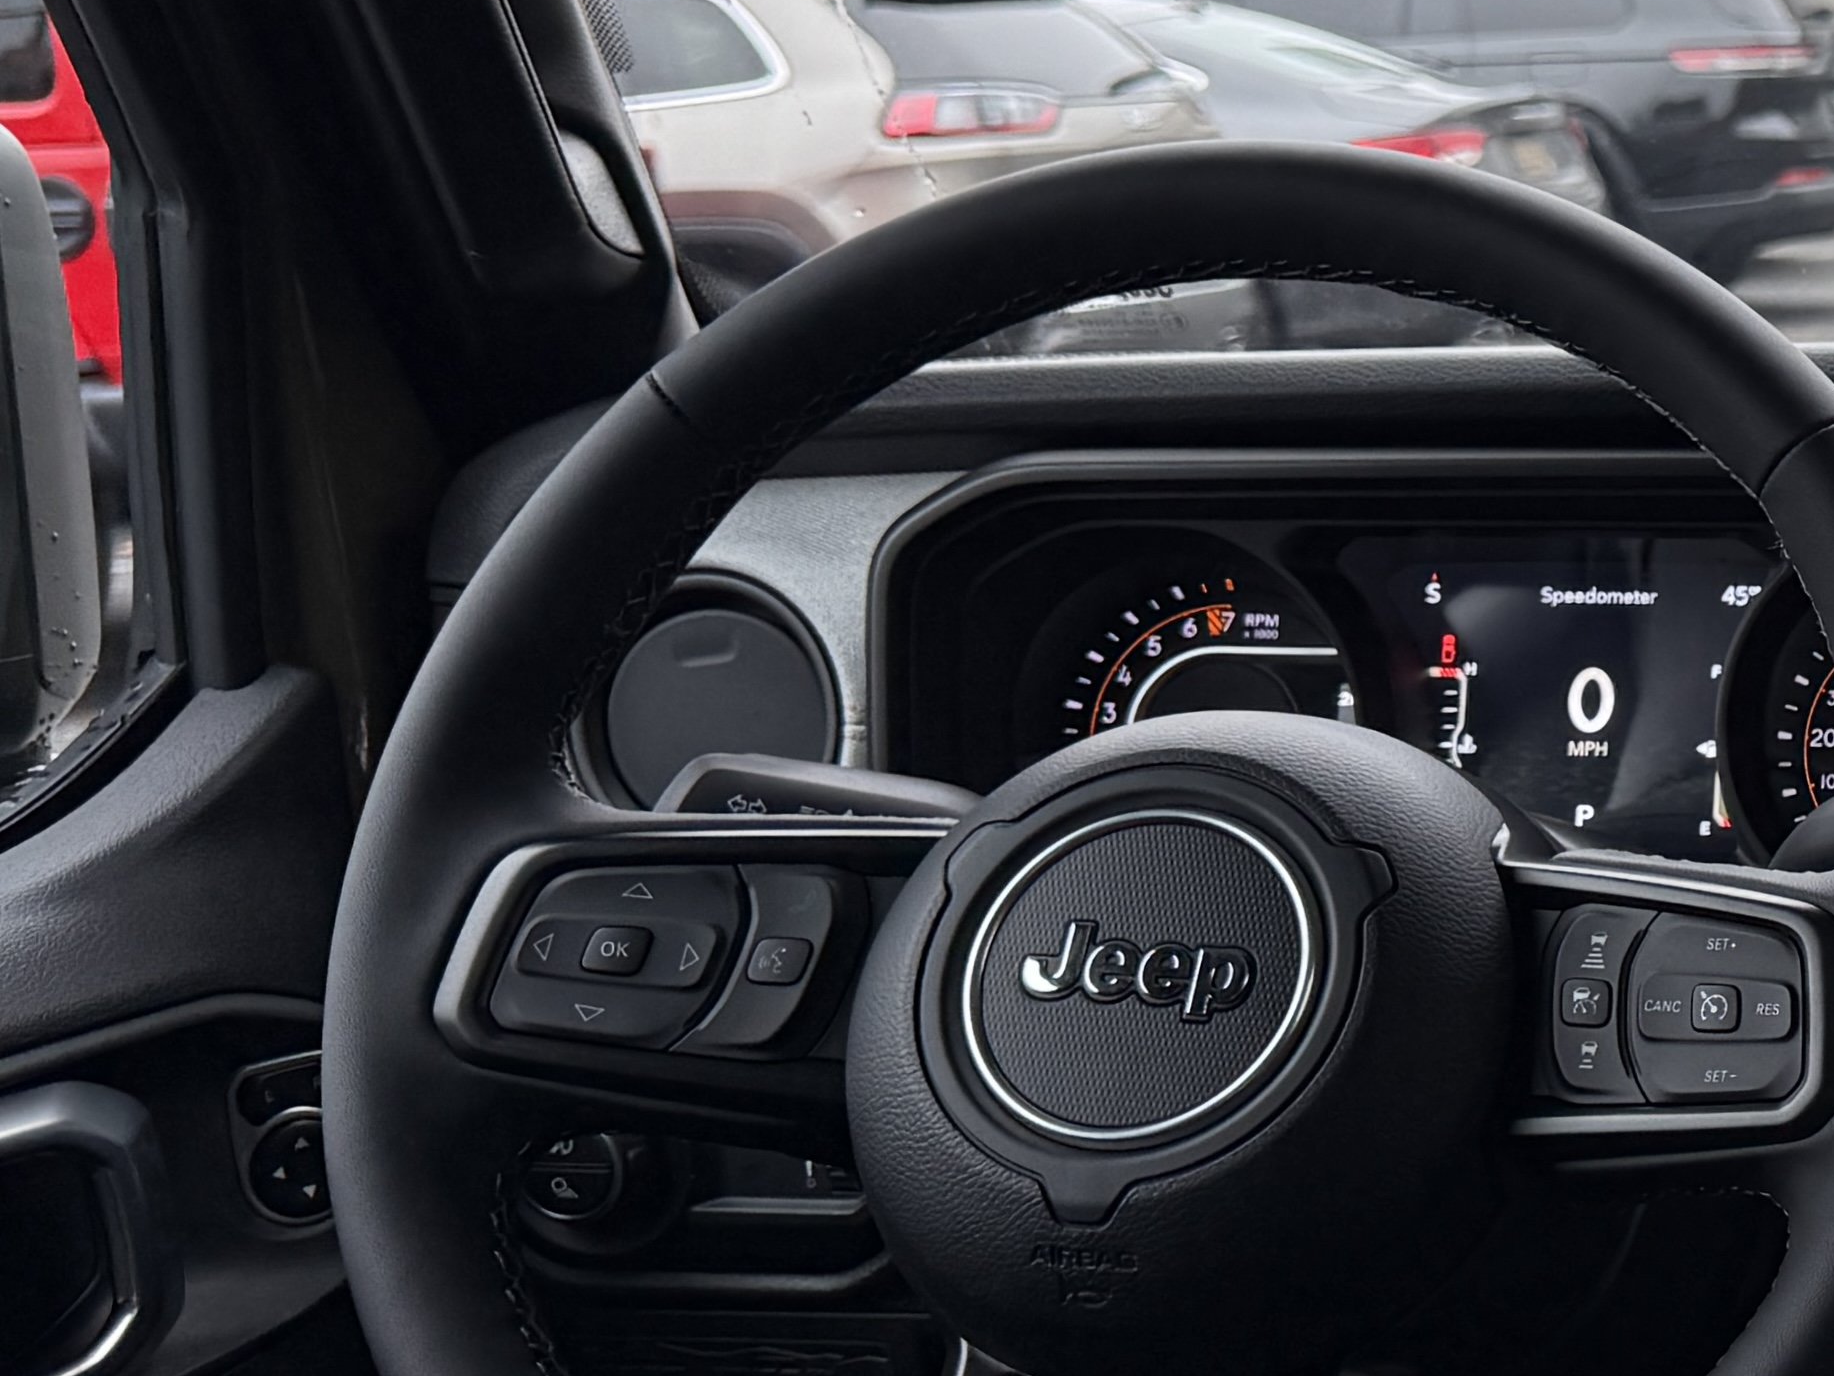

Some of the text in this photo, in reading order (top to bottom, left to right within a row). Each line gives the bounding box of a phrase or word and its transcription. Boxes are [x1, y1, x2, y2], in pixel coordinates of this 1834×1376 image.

[1540, 586, 1659, 608] Speedometer
[1180, 617, 1198, 640] 6
[1243, 613, 1281, 629] RPM
[1145, 634, 1163, 658] 5
[1566, 666, 1616, 734] 0
[1102, 701, 1118, 725] 3
[1566, 741, 1609, 758] MPH
[1574, 803, 1596, 827] P
[599, 940, 630, 959] OK
[1018, 920, 1257, 1023] Jeep
[1643, 999, 1682, 1014] CANC
[1755, 1002, 1780, 1017] RES
